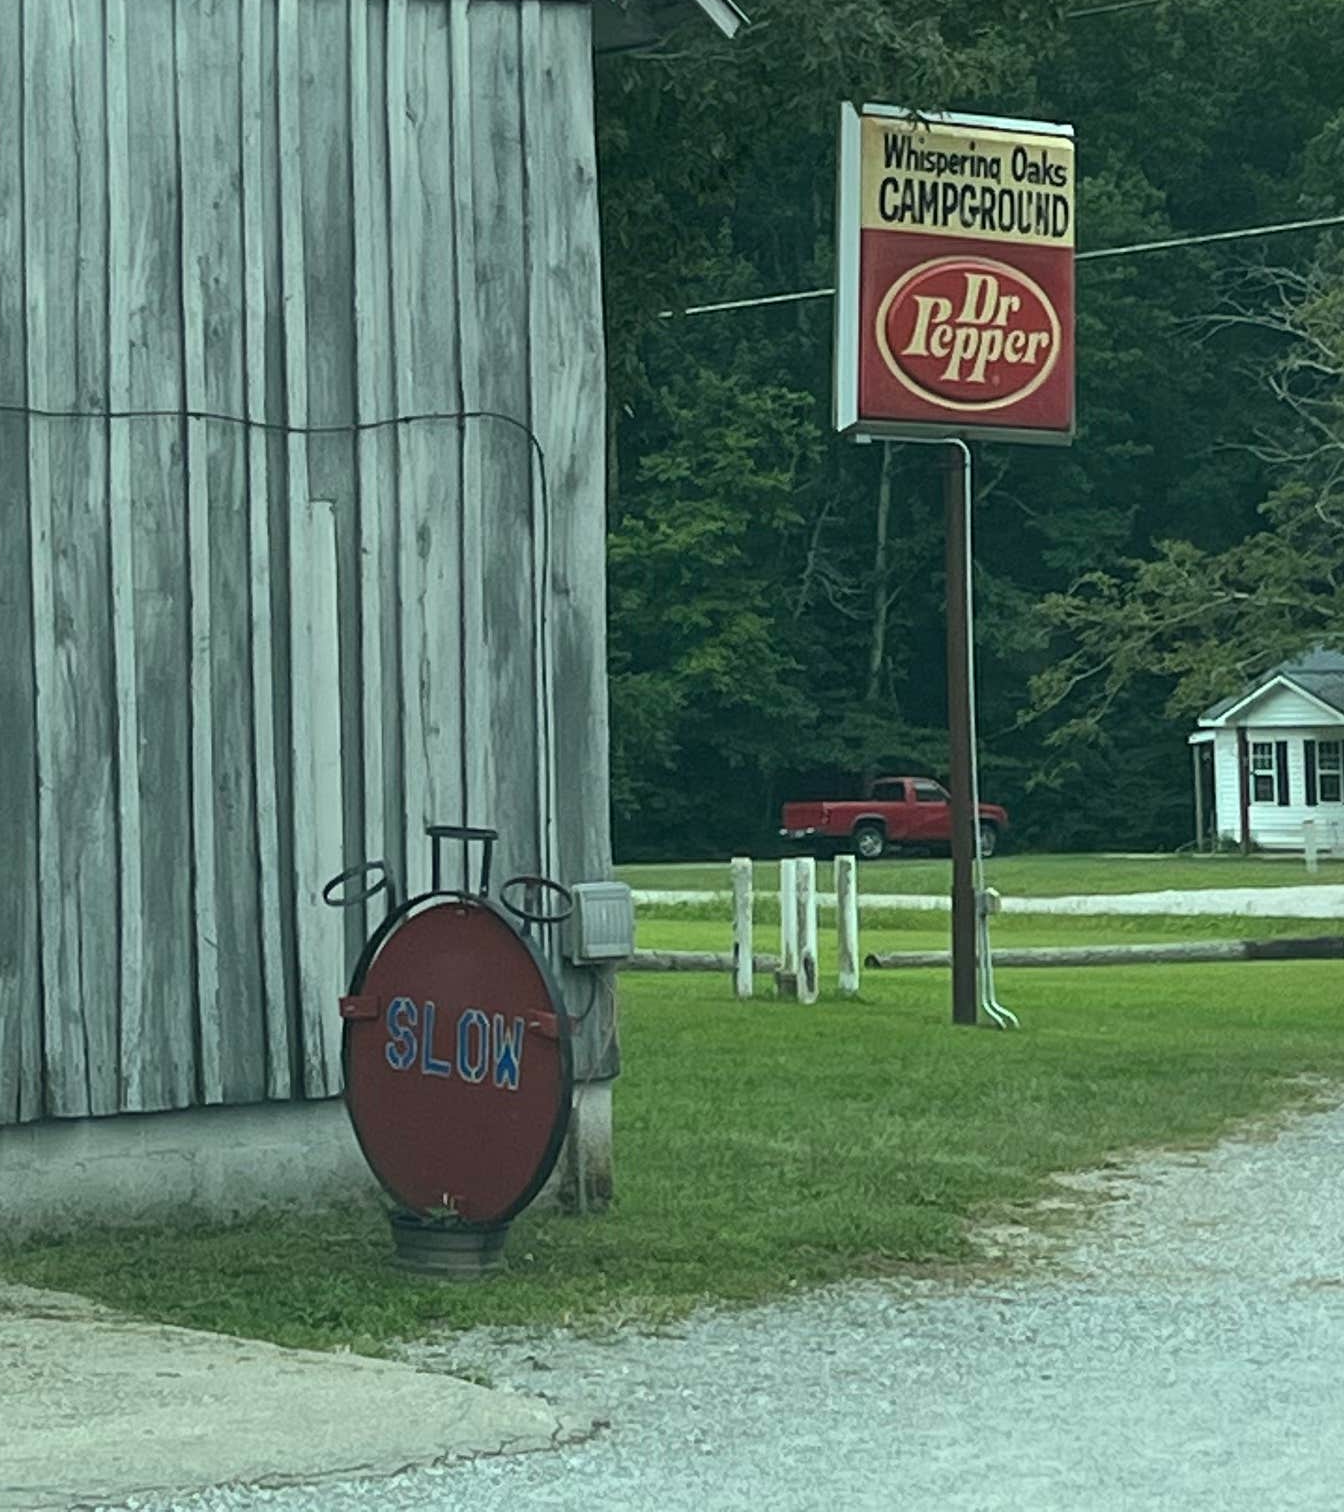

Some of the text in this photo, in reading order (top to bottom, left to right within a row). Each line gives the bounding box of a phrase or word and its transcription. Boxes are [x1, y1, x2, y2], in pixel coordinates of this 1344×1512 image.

[883, 133, 1068, 188] Whispering Oaks
[878, 176, 1070, 238] CAMPGROUND
[955, 272, 1021, 327] Dr
[902, 294, 1050, 384] Pepper
[385, 996, 525, 1091] SLOW
